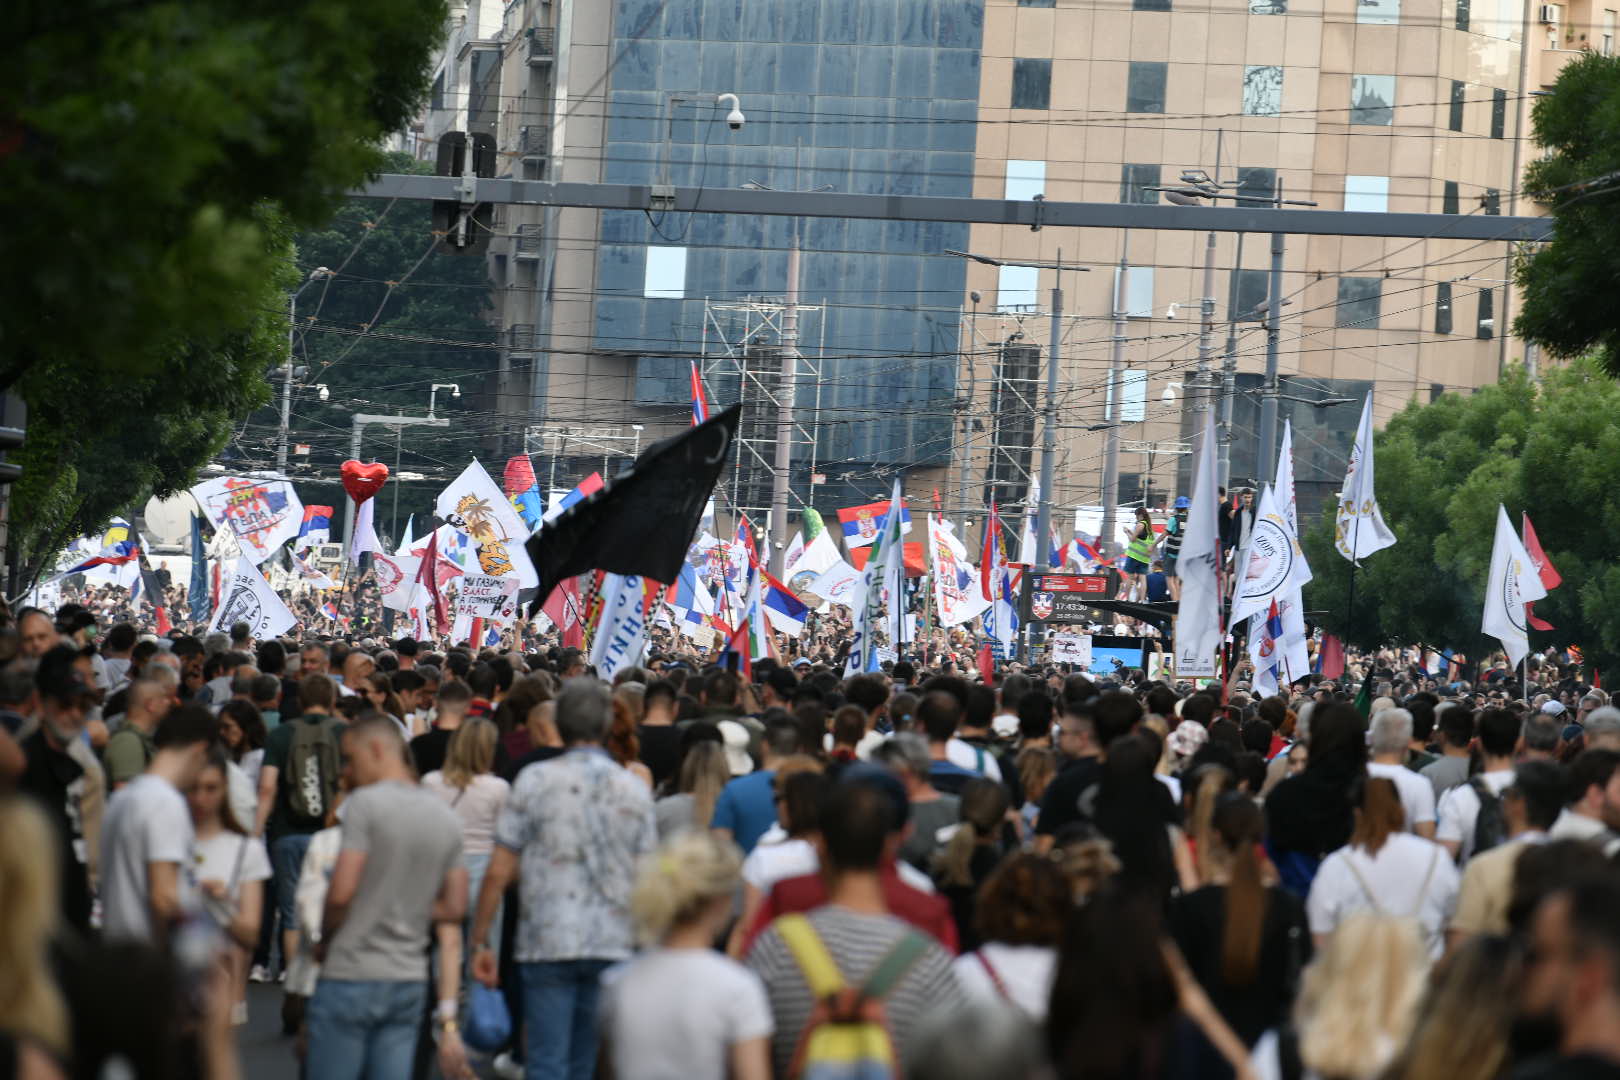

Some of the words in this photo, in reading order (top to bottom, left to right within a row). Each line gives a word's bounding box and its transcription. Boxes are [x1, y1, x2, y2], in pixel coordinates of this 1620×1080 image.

[463, 586, 491, 596] ВЛАСТ
[459, 604, 479, 616] НАС
[302, 754, 322, 817] adidas
